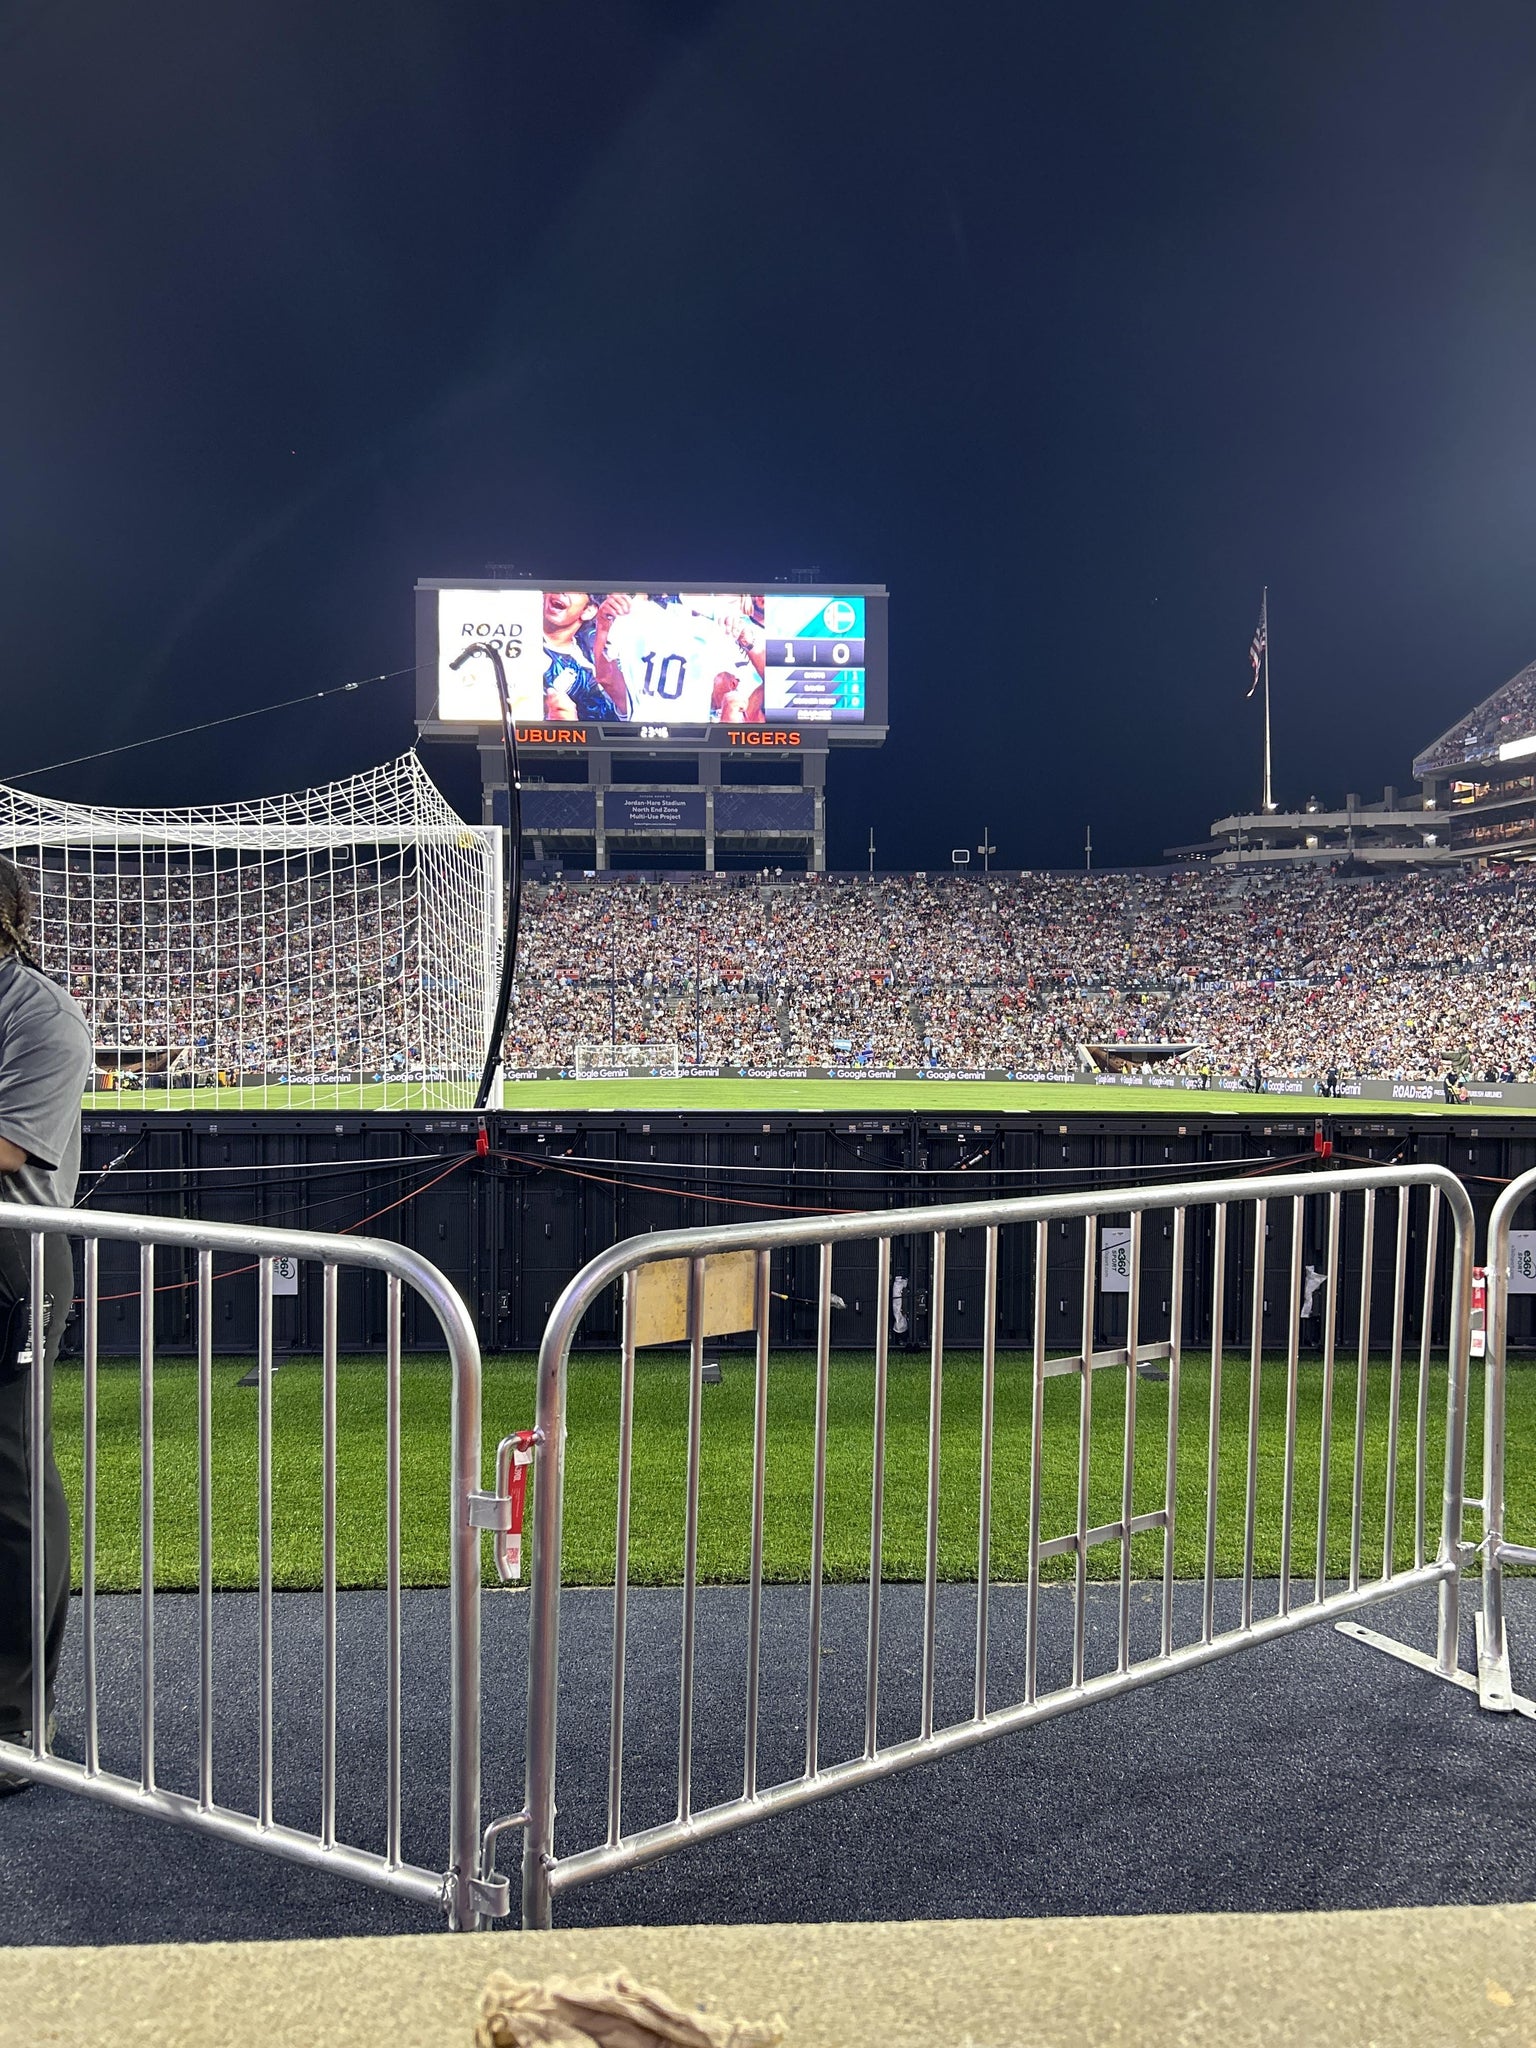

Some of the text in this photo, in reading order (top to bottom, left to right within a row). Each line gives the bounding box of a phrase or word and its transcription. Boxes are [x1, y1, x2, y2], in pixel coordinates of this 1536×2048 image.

[461, 623, 522, 636] ROAD
[784, 642, 850, 664] 1 0
[641, 651, 687, 699] 10
[502, 729, 801, 745] UBURN TIGERS
[660, 813, 681, 821] Project
[289, 1073, 351, 1085] Google Gemini
[382, 1071, 413, 1082] Google
[507, 1070, 538, 1079] Gemini
[600, 1067, 629, 1078] Gemini
[659, 1067, 720, 1078] Google Gemini
[748, 1068, 807, 1079] Google Gemini
[837, 1069, 896, 1080] Google Gemini
[926, 1070, 986, 1081] Google Gemini
[1015, 1071, 1075, 1082] Google Gemini
[1223, 1078, 1238, 1091] Google
[1267, 1079, 1285, 1094] Google
[1286, 1080, 1303, 1092] Gemini
[1340, 1081, 1362, 1095] Gemini
[1392, 1084, 1416, 1098] ROAD
[280, 1256, 289, 1277] 360
[1117, 1247, 1127, 1275] e360
[1523, 1249, 1532, 1278] e360
